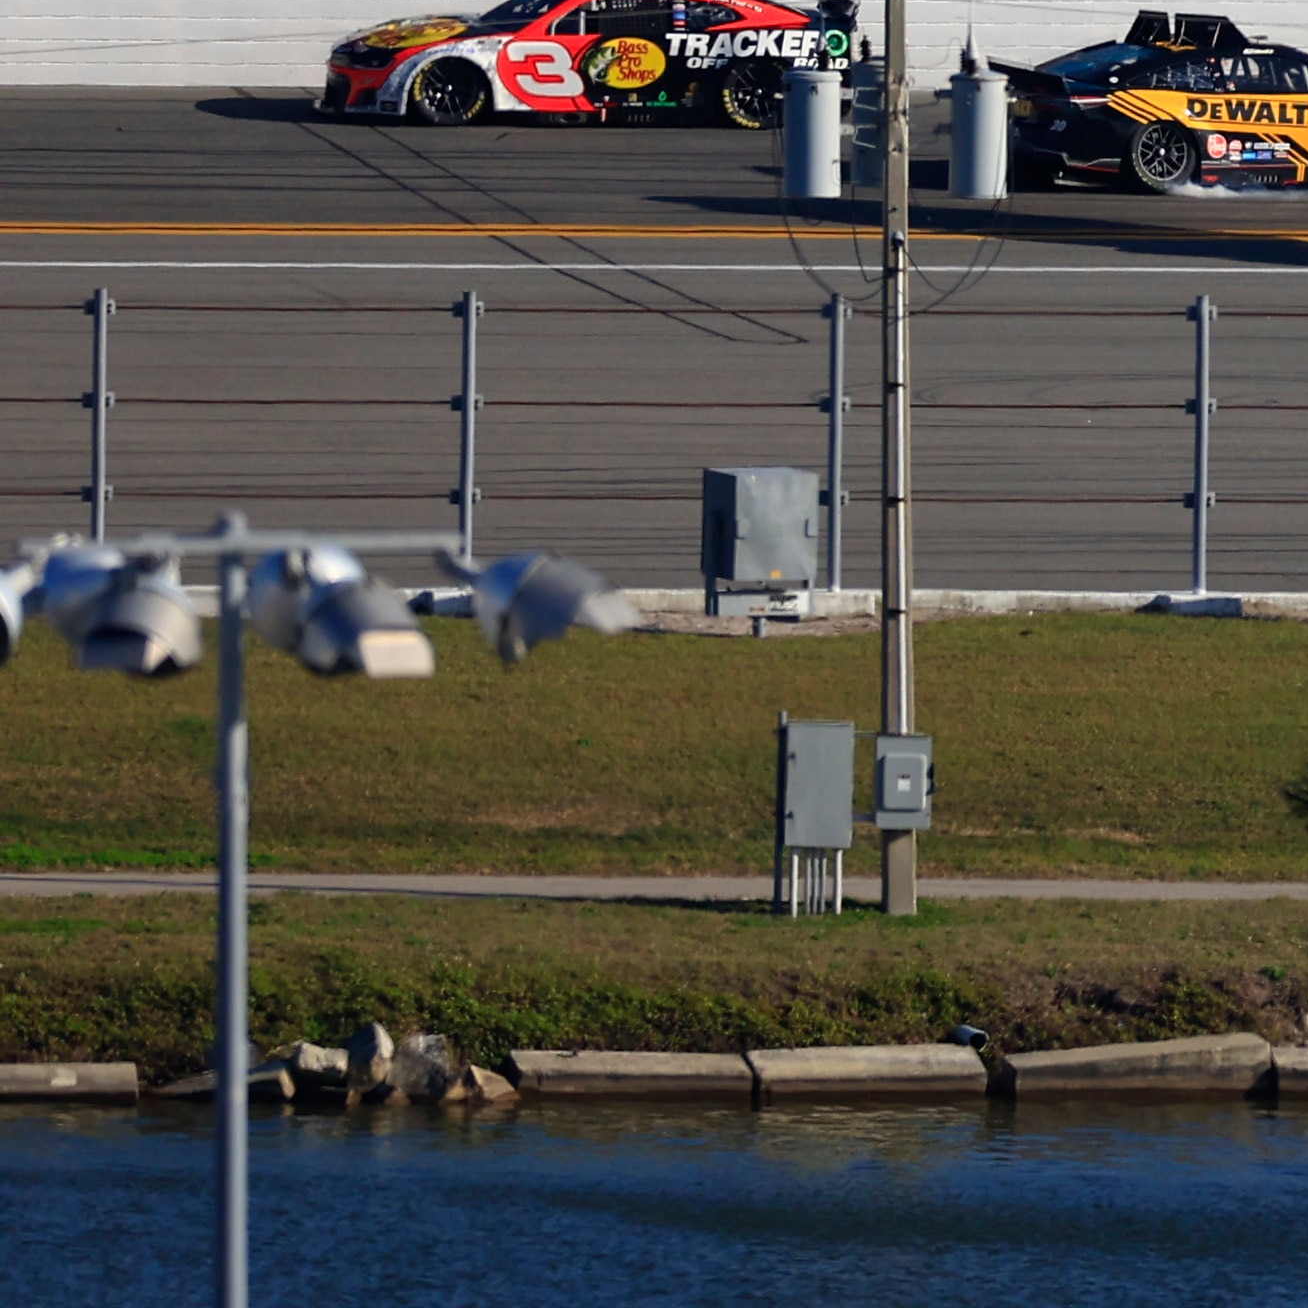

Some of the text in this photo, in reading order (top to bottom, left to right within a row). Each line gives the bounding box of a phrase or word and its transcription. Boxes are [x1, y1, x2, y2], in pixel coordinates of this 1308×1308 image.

[616, 41, 649, 54] Bass
[665, 30, 820, 57] TRACKER
[618, 54, 641, 68] Pro
[686, 58, 729, 69] OFF
[506, 41, 584, 97] 3
[616, 67, 657, 83] Shops
